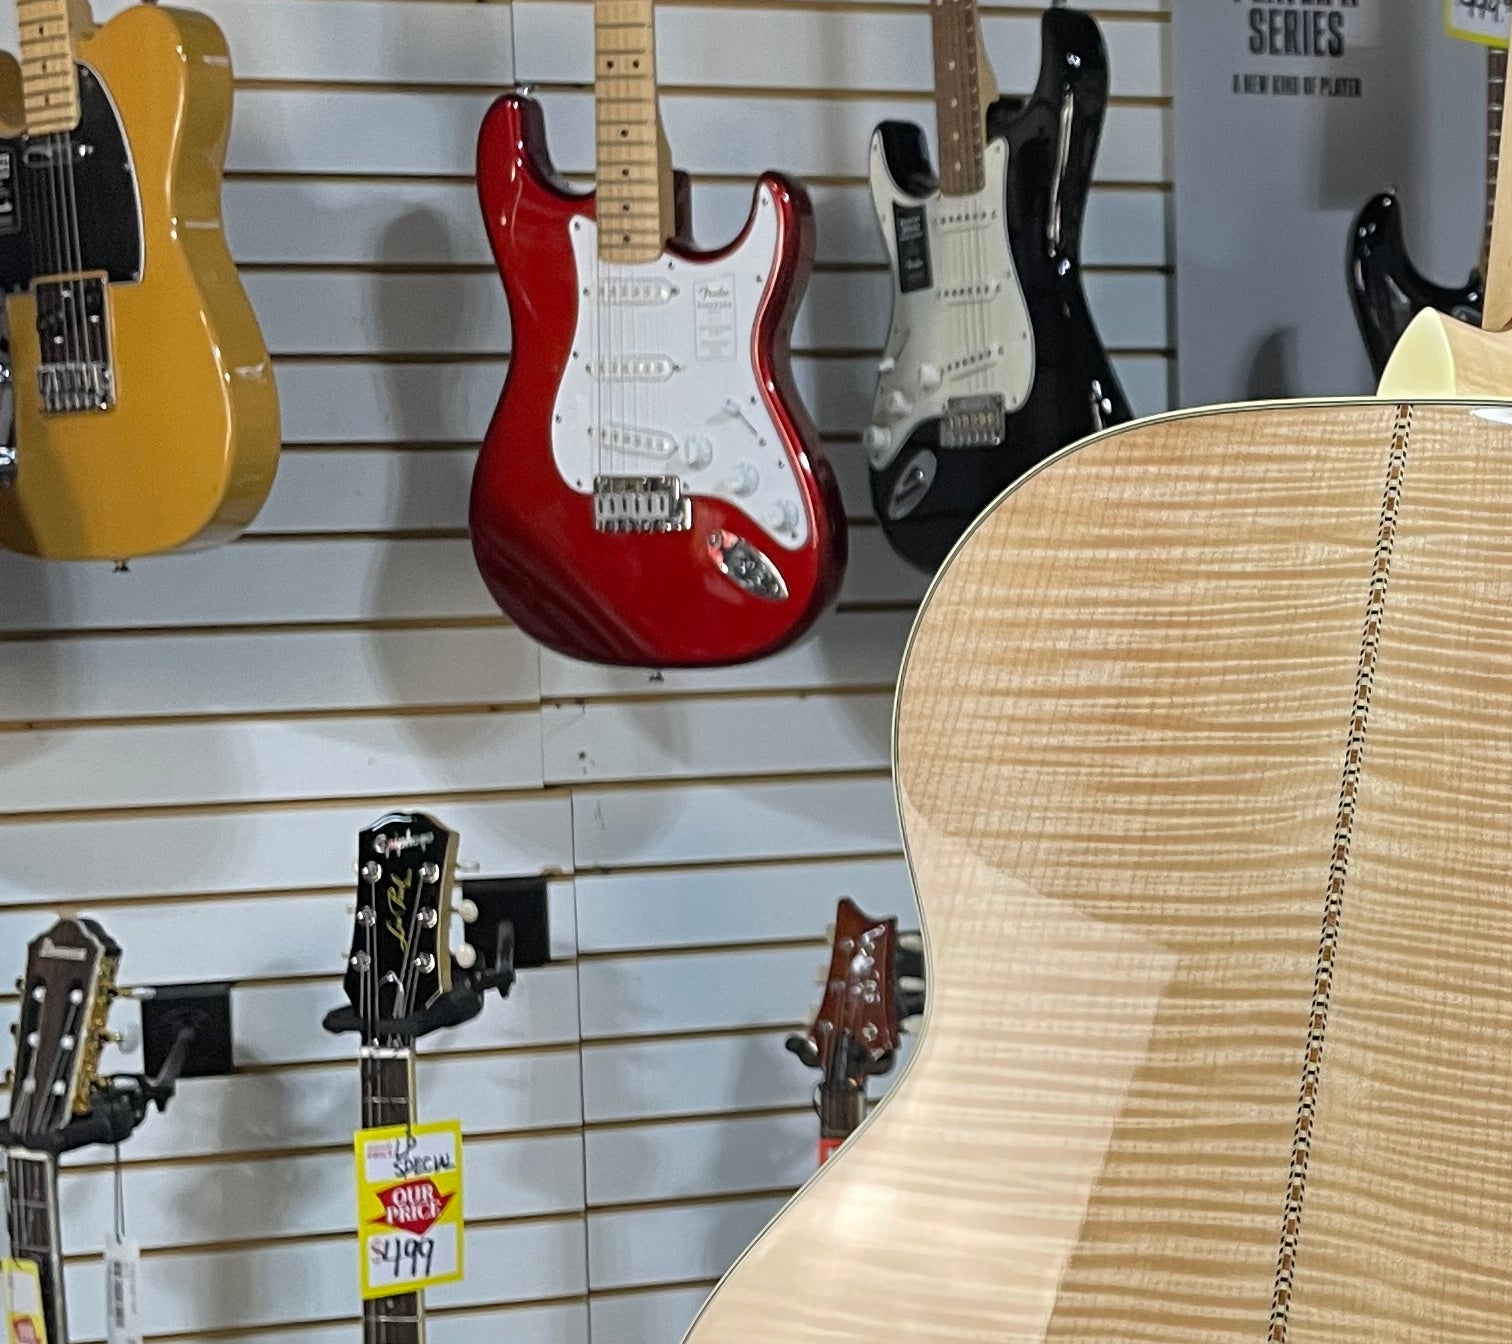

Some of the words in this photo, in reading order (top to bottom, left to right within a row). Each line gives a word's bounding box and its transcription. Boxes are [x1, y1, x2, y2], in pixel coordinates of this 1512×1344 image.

[1249, 7, 1345, 57] SERIES
[1233, 74, 1241, 94] A
[1320, 76, 1363, 98] PLAYER
[392, 1183, 434, 1205] OUR
[386, 1200, 442, 1224] PRICE
